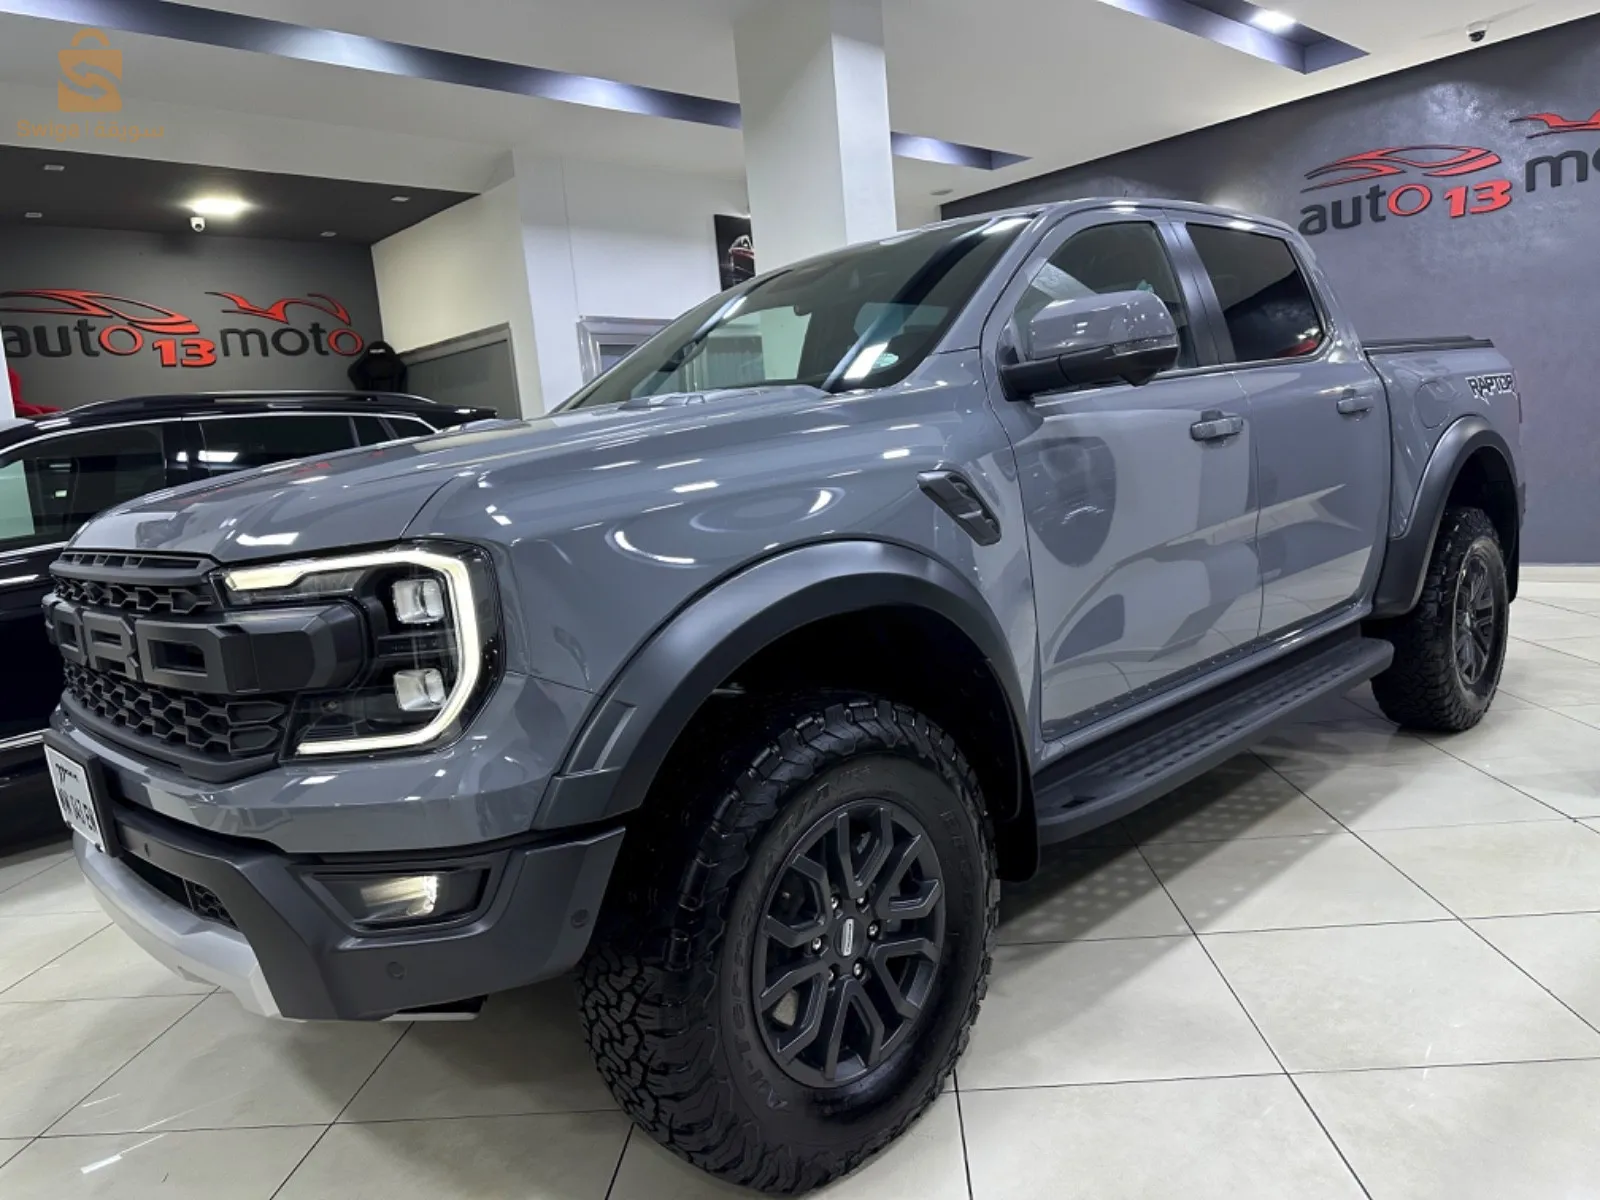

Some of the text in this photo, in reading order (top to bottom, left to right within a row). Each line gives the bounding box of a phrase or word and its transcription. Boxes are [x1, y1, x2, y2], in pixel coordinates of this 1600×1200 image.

[1298, 180, 1513, 236] auto 13
[0, 319, 364, 367] auto 13 moto
